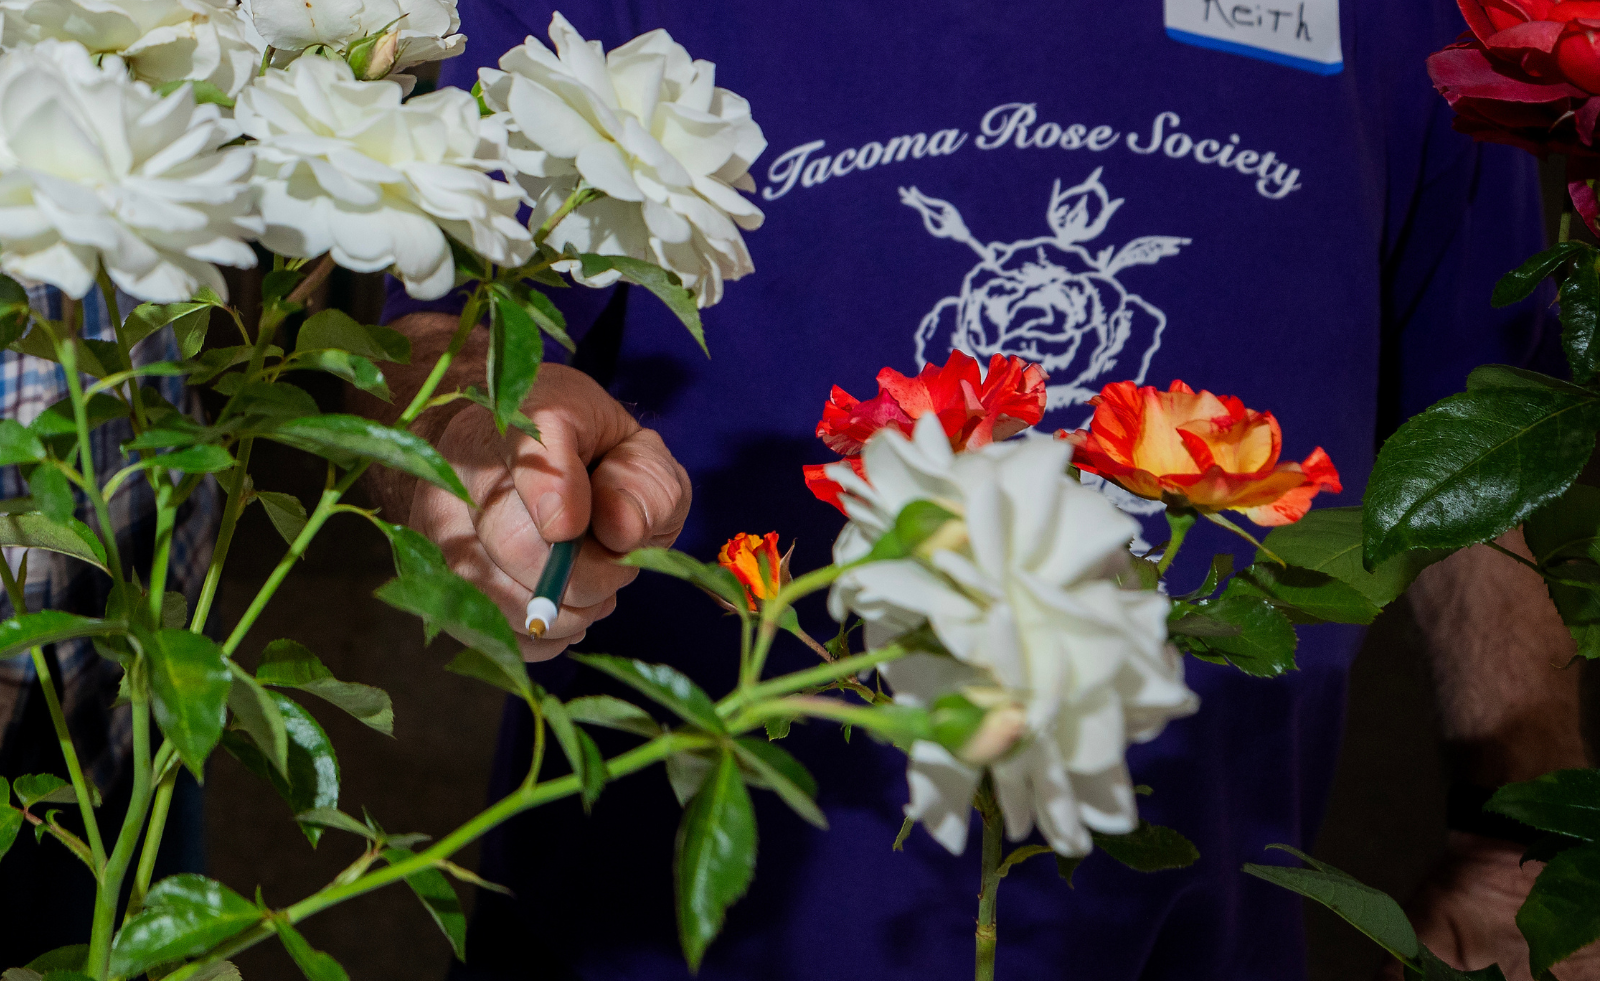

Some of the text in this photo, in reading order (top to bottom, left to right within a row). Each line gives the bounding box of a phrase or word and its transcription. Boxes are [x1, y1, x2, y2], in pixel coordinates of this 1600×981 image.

[762, 101, 1302, 202] Tacoma Rose Society
